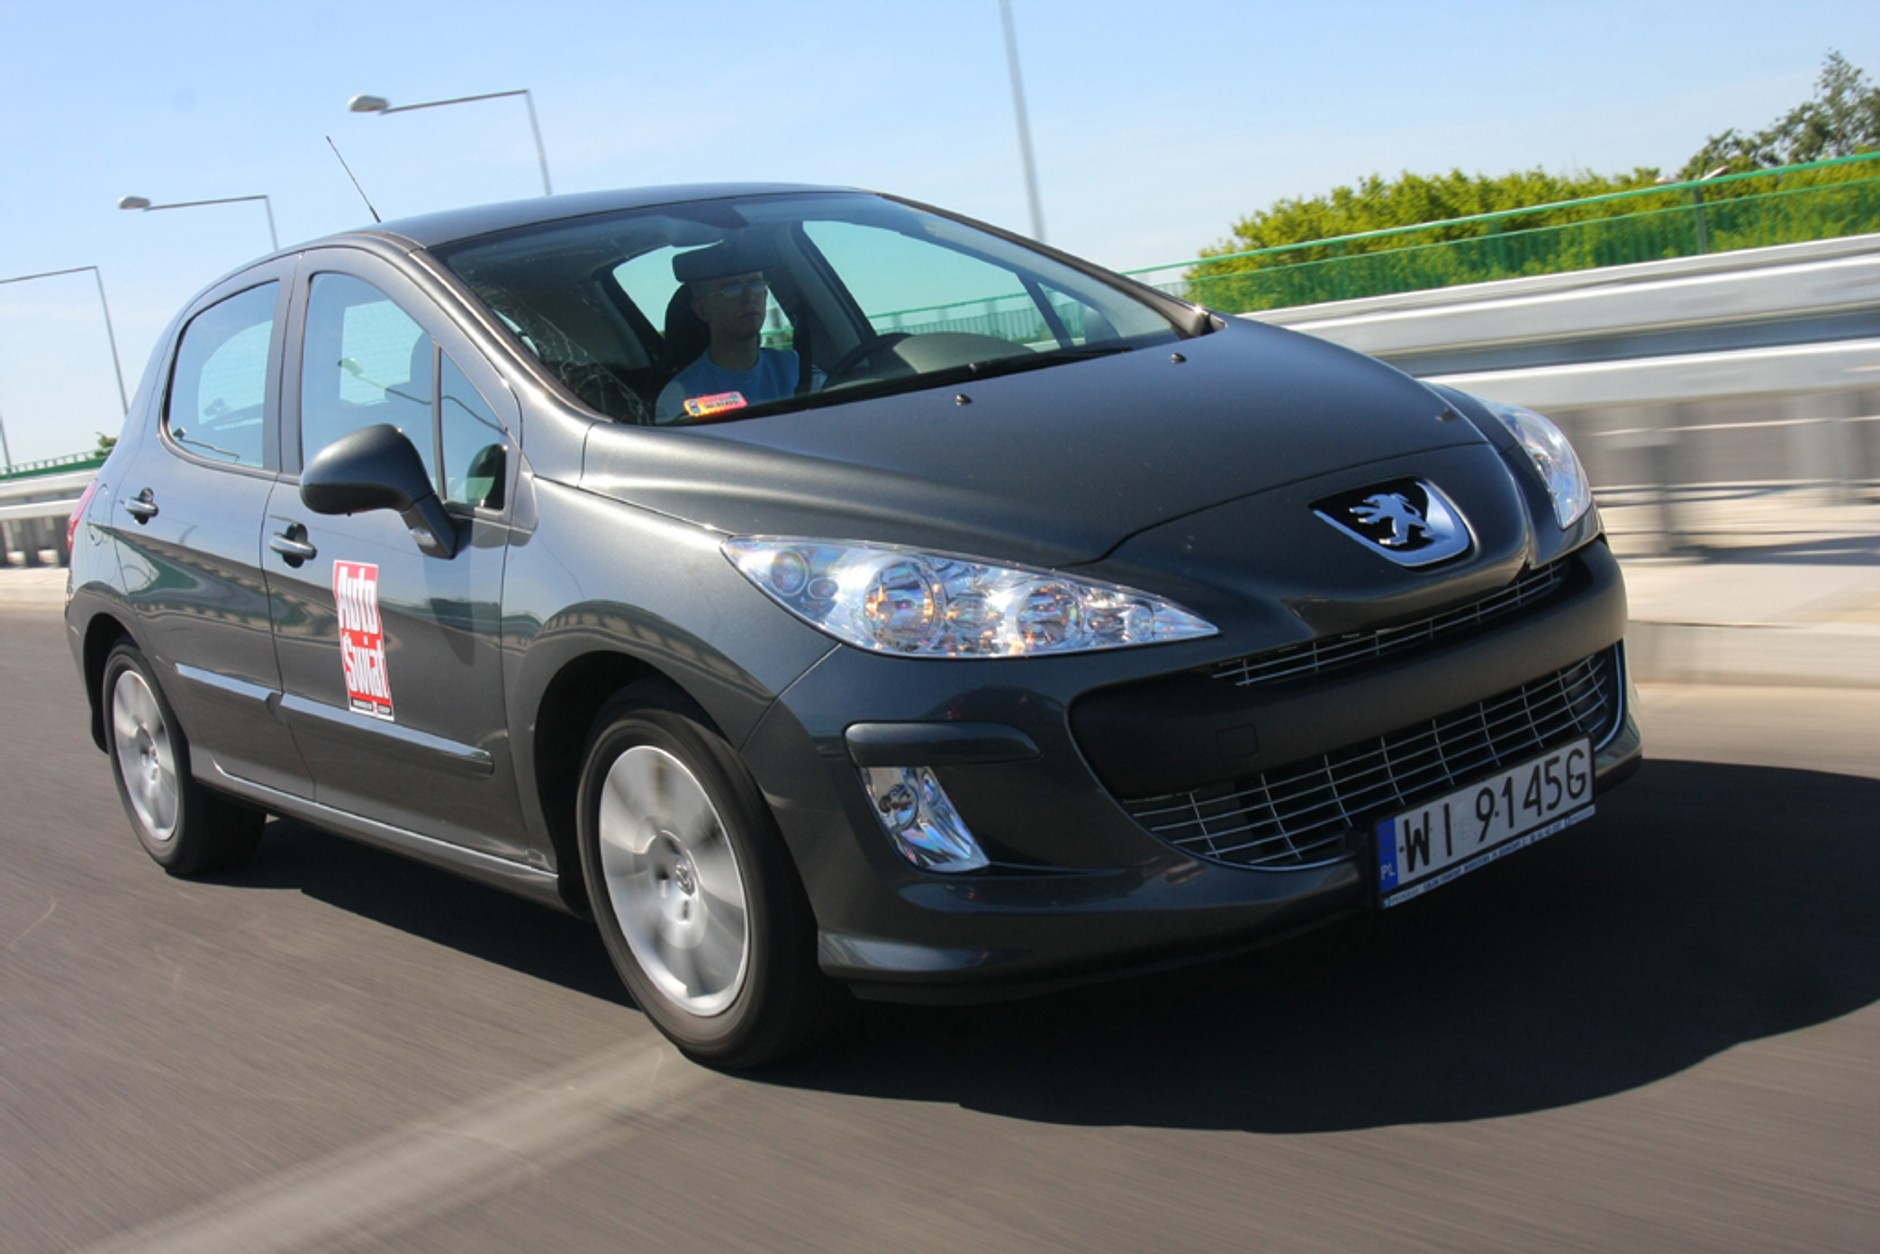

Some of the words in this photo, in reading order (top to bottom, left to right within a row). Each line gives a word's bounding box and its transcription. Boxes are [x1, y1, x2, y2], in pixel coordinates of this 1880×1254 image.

[338, 566, 379, 634] Auto
[1403, 803, 1453, 872] WI
[1475, 748, 1586, 843] 9145G
[1380, 863, 1396, 880] PL
